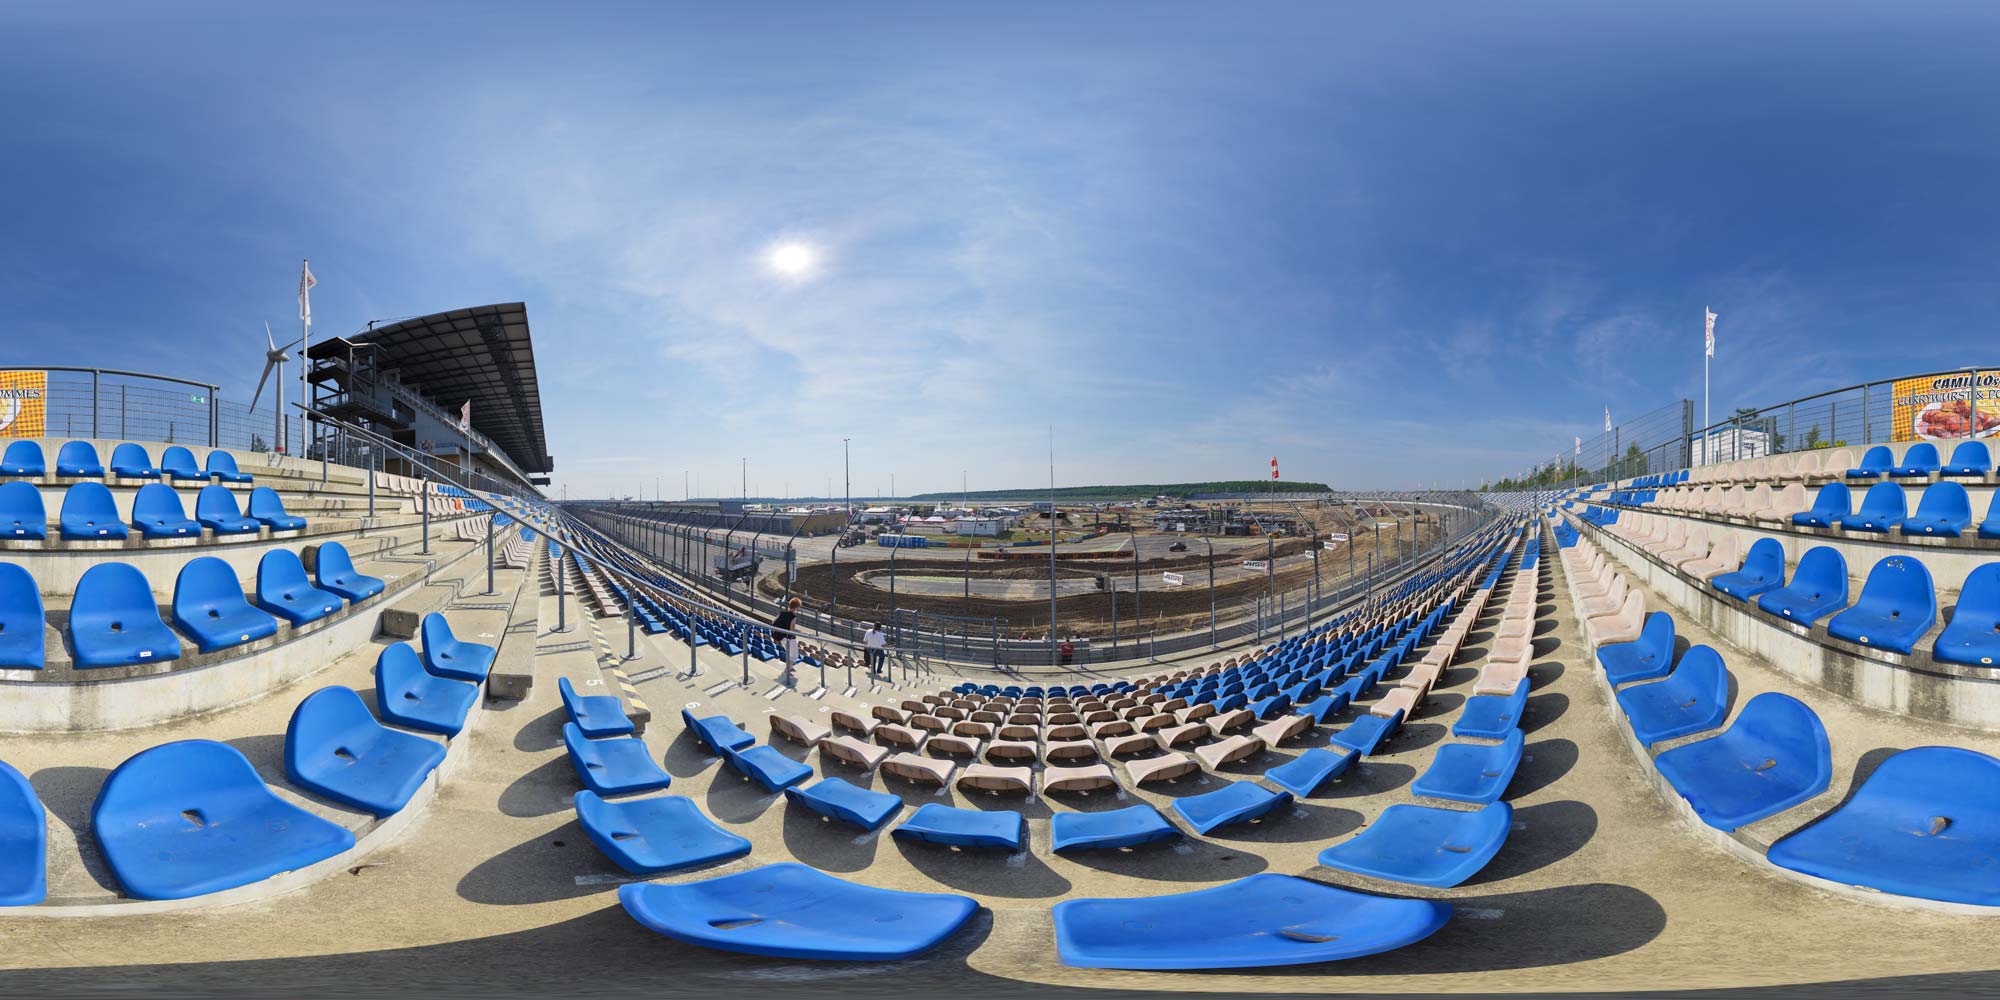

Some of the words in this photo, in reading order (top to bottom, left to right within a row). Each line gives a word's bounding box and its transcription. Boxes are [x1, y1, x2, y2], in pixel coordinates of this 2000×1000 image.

[1897, 391, 1971, 406] CURRYWURST
[1976, 390, 1985, 400] &
[685, 701, 701, 709] 6
